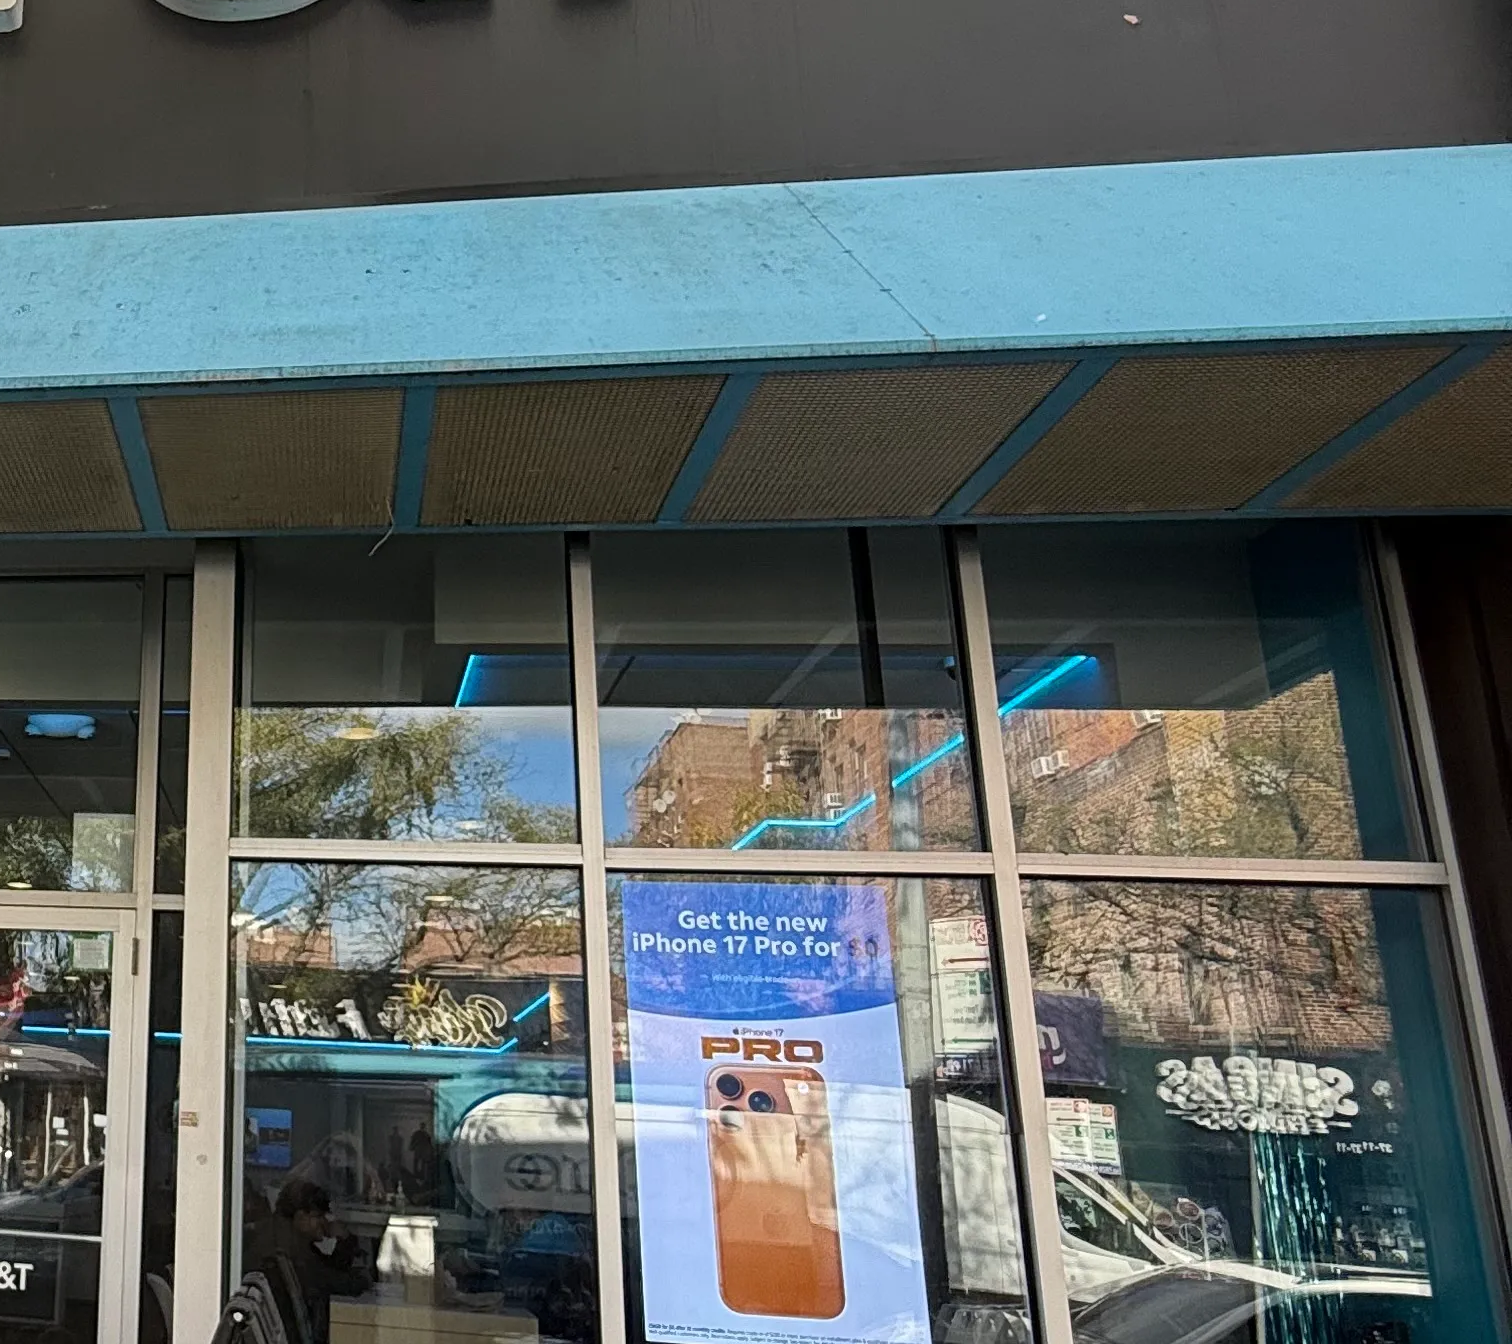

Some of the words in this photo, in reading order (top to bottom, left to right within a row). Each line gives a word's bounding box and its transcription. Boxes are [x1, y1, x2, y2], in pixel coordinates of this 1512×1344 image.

[677, 910, 721, 931] Get
[727, 910, 770, 932] the
[776, 915, 828, 933] new
[632, 932, 718, 954] iPhone
[722, 935, 748, 954] 17
[754, 935, 798, 956] Pro
[802, 936, 841, 957] for
[740, 1027, 773, 1037] iPhone
[774, 1028, 785, 1038] 17
[700, 1036, 824, 1063] PRO
